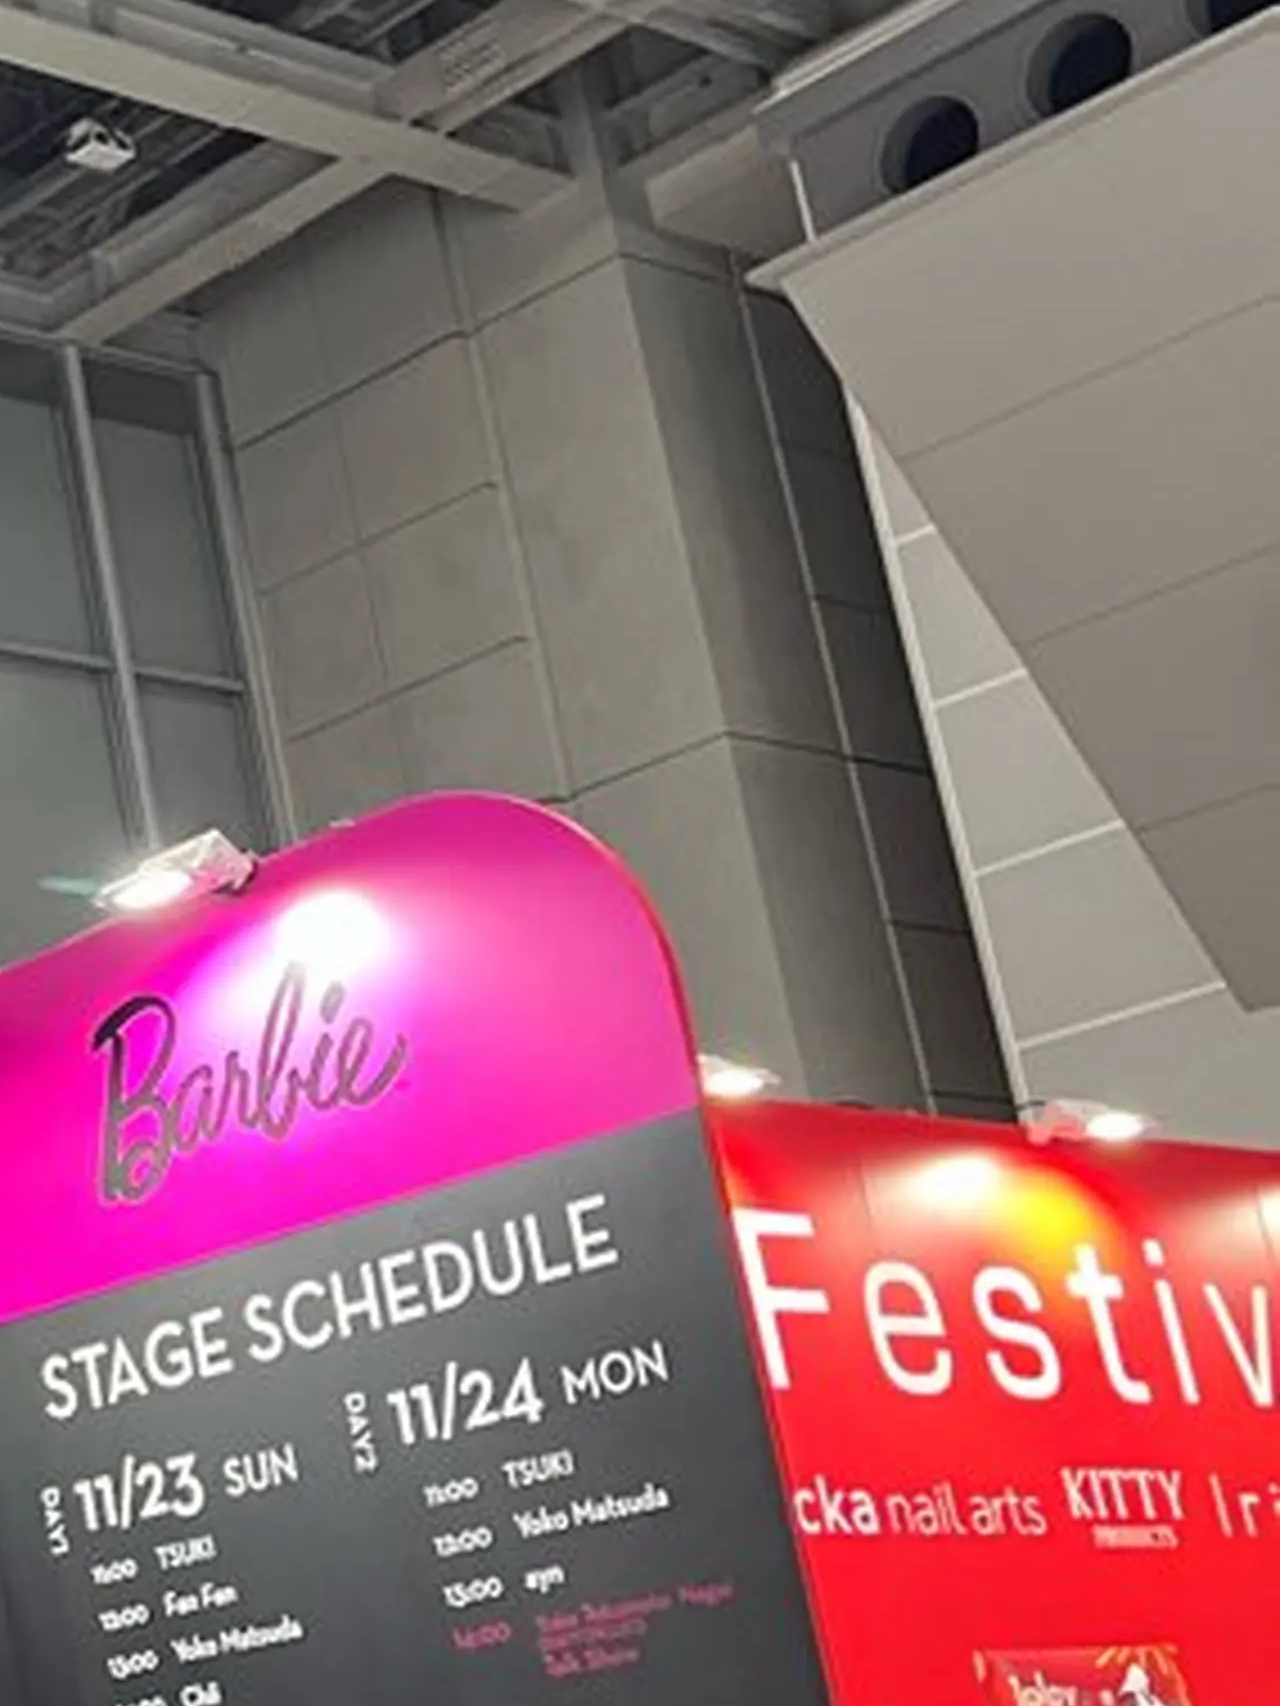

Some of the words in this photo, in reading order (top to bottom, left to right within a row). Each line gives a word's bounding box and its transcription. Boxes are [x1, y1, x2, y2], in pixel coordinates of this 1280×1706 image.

[91, 960, 409, 1207] Barbie
[41, 1308, 234, 1420] STAGE
[247, 1195, 618, 1363] SCHEDULE
[344, 1392, 378, 1473] DAY2
[387, 1358, 544, 1444] 11/24
[561, 1340, 669, 1404] MON
[73, 1453, 205, 1531] 11/23
[223, 1443, 298, 1496] SUN
[502, 1448, 575, 1488] TSUKI
[1061, 1466, 1184, 1520] KITTY
[41, 1487, 70, 1556] DAY1
[513, 1506, 569, 1539] Yoko
[570, 1482, 670, 1526] Matsuda
